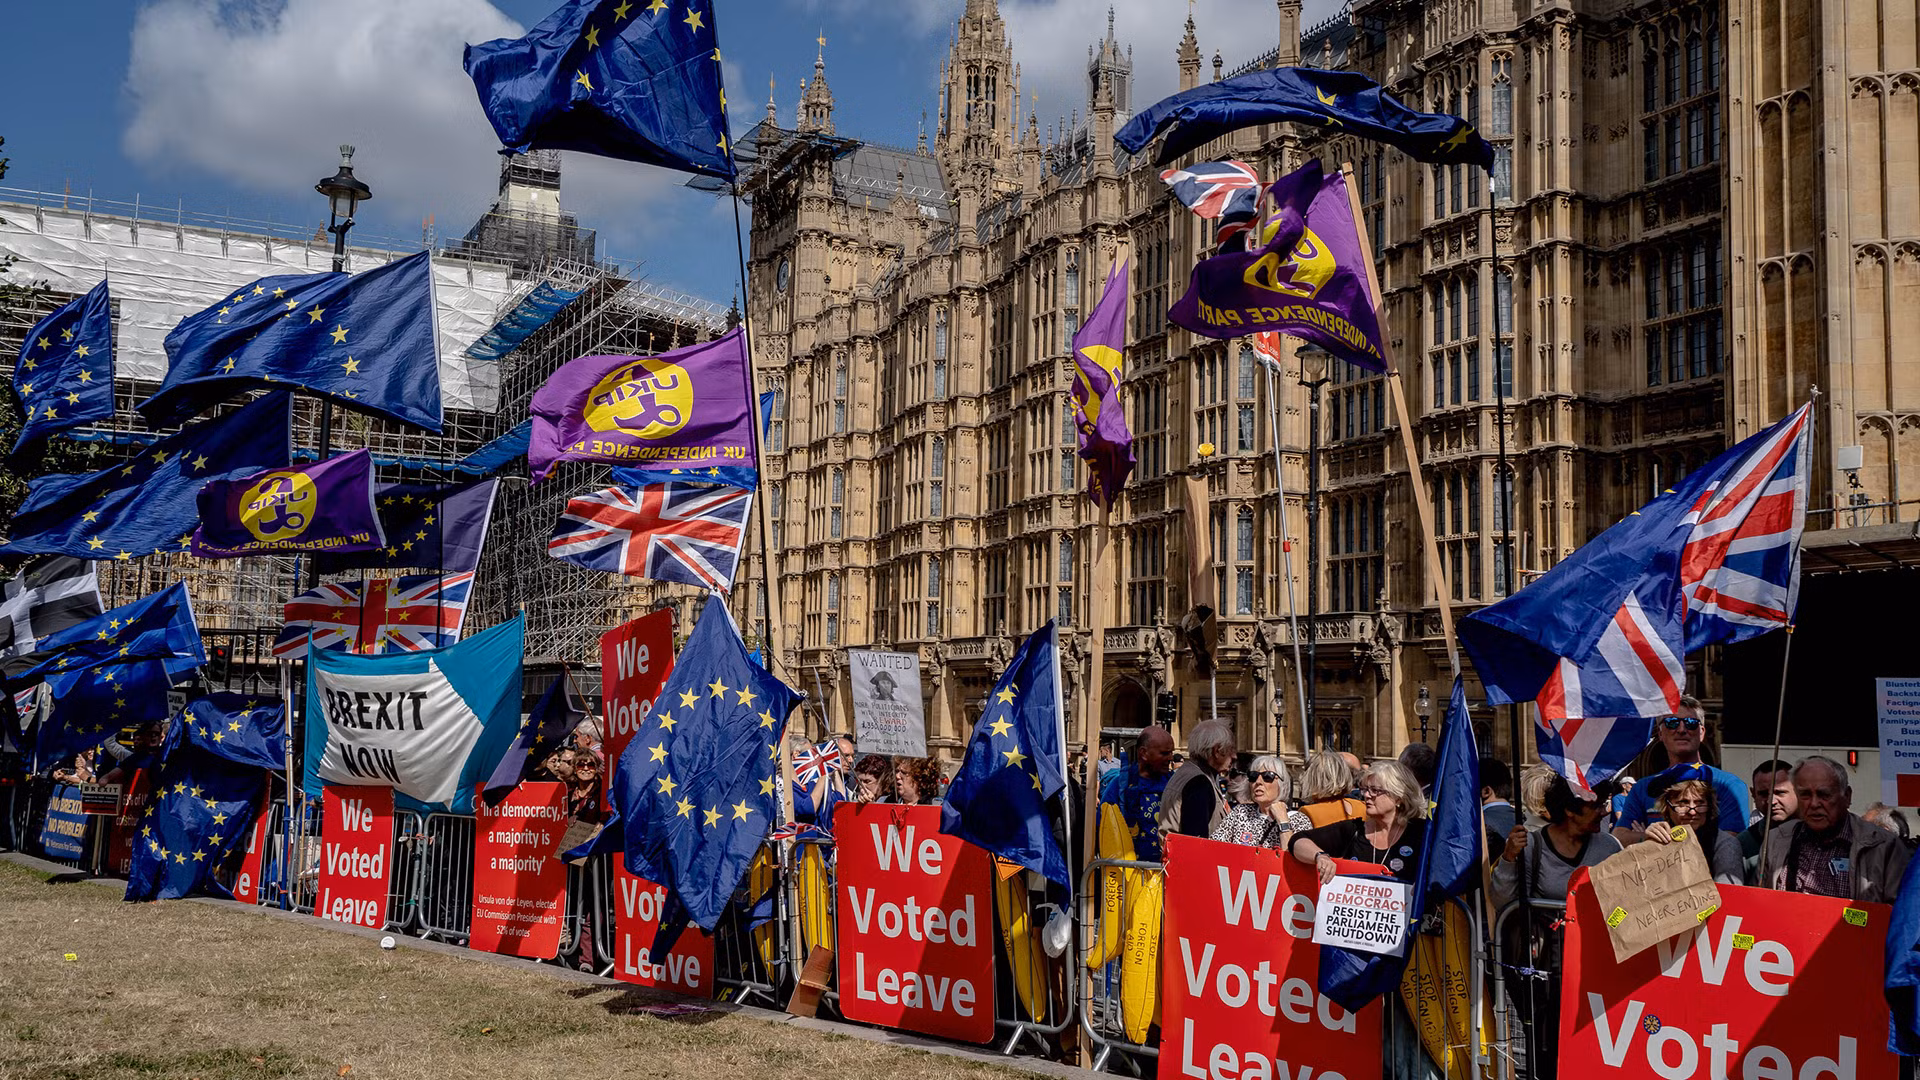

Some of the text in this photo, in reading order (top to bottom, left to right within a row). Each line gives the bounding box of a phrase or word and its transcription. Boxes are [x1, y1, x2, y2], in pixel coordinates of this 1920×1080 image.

[616, 637, 649, 681] We
[858, 653, 912, 669] WANTED
[326, 687, 427, 730] BREXIT
[1886, 699, 1920, 707] Factign
[340, 742, 402, 785] NOW
[84, 785, 118, 793] BREXIT
[47, 818, 57, 832] NO
[341, 799, 373, 833] We
[494, 806, 499, 816] a
[488, 831, 494, 843] a
[496, 829, 539, 848] majority
[542, 831, 550, 845] is
[870, 823, 943, 875] We
[326, 843, 384, 879] Voted
[491, 858, 496, 869] a
[1621, 848, 1691, 892] NO-DEAL
[479, 894, 494, 904] Ursula
[495, 896, 505, 905] von
[506, 896, 515, 906] der
[536, 899, 557, 909] elected
[1107, 871, 1117, 912] FOREIGN
[1217, 865, 1315, 939] We
[1326, 892, 1408, 912] DEMOCRACY
[1345, 883, 1393, 898] DEFEND
[322, 888, 378, 926] Leave
[476, 909, 556, 924] EU Commission President with
[847, 886, 976, 947] Voted
[1332, 906, 1397, 924] RESIST THE
[1635, 889, 1718, 930] NEVER-ENDING
[496, 925, 508, 935] 52%
[515, 927, 530, 937] votes
[1326, 915, 1401, 935] PARLIAMENT
[1326, 925, 1397, 945] SHUTDOWN
[1134, 922, 1147, 965] FOREIGN
[1149, 935, 1157, 959] STOP
[1656, 915, 1795, 997] We
[625, 933, 700, 988] Leave
[855, 952, 976, 1017] Leave
[1402, 981, 1413, 1000] AID
[1420, 973, 1437, 1002] STOP
[1452, 970, 1467, 1000] STOP
[1182, 1017, 1348, 1080] Leav
[1587, 991, 1857, 1080] Voted
